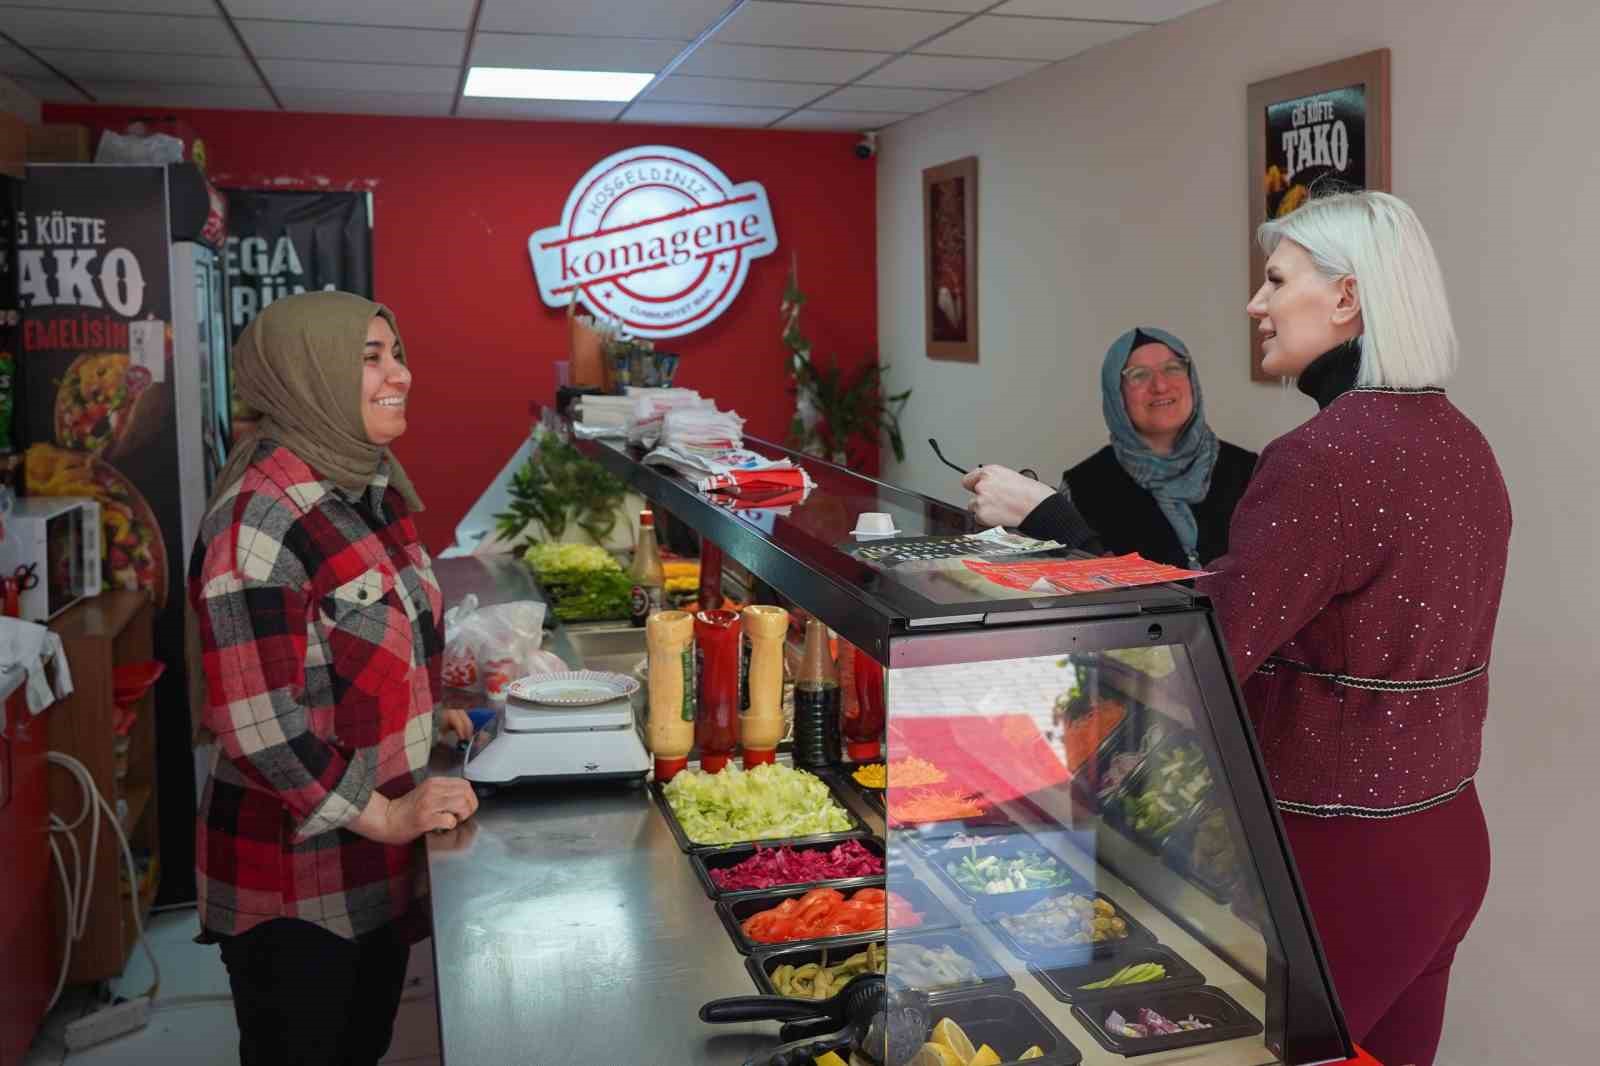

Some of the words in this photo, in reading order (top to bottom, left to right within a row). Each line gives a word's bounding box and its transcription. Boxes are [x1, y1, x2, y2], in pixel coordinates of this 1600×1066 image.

[1282, 120, 1349, 184] TAKO
[35, 211, 106, 244] KÖFTE
[561, 212, 759, 280] komagene
[224, 236, 303, 275] EGA
[18, 248, 146, 317] AKO
[23, 314, 129, 352] EMELİSİN
